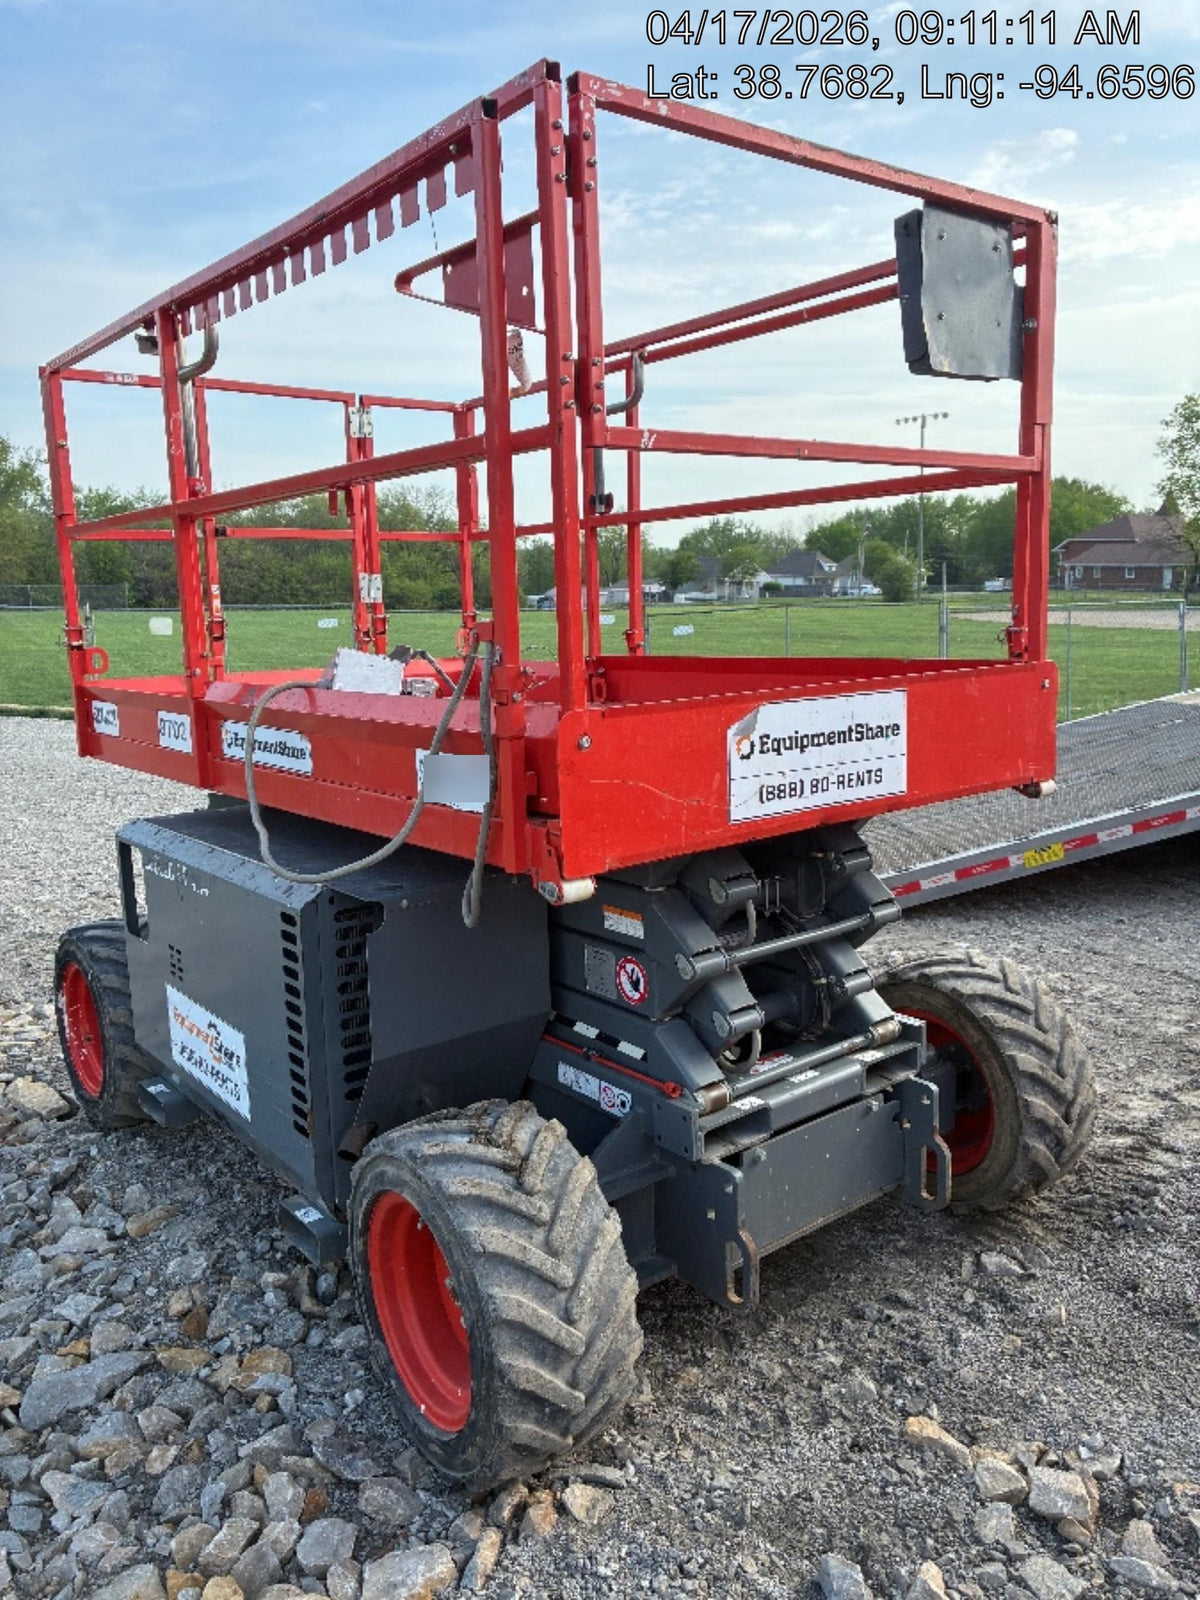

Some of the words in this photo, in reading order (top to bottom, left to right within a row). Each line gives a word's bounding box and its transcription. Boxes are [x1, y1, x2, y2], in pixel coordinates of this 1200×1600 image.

[758, 722, 901, 757] EquipmentShare
[758, 778, 805, 804] (888)
[810, 767, 883, 795] 80-RENTS
